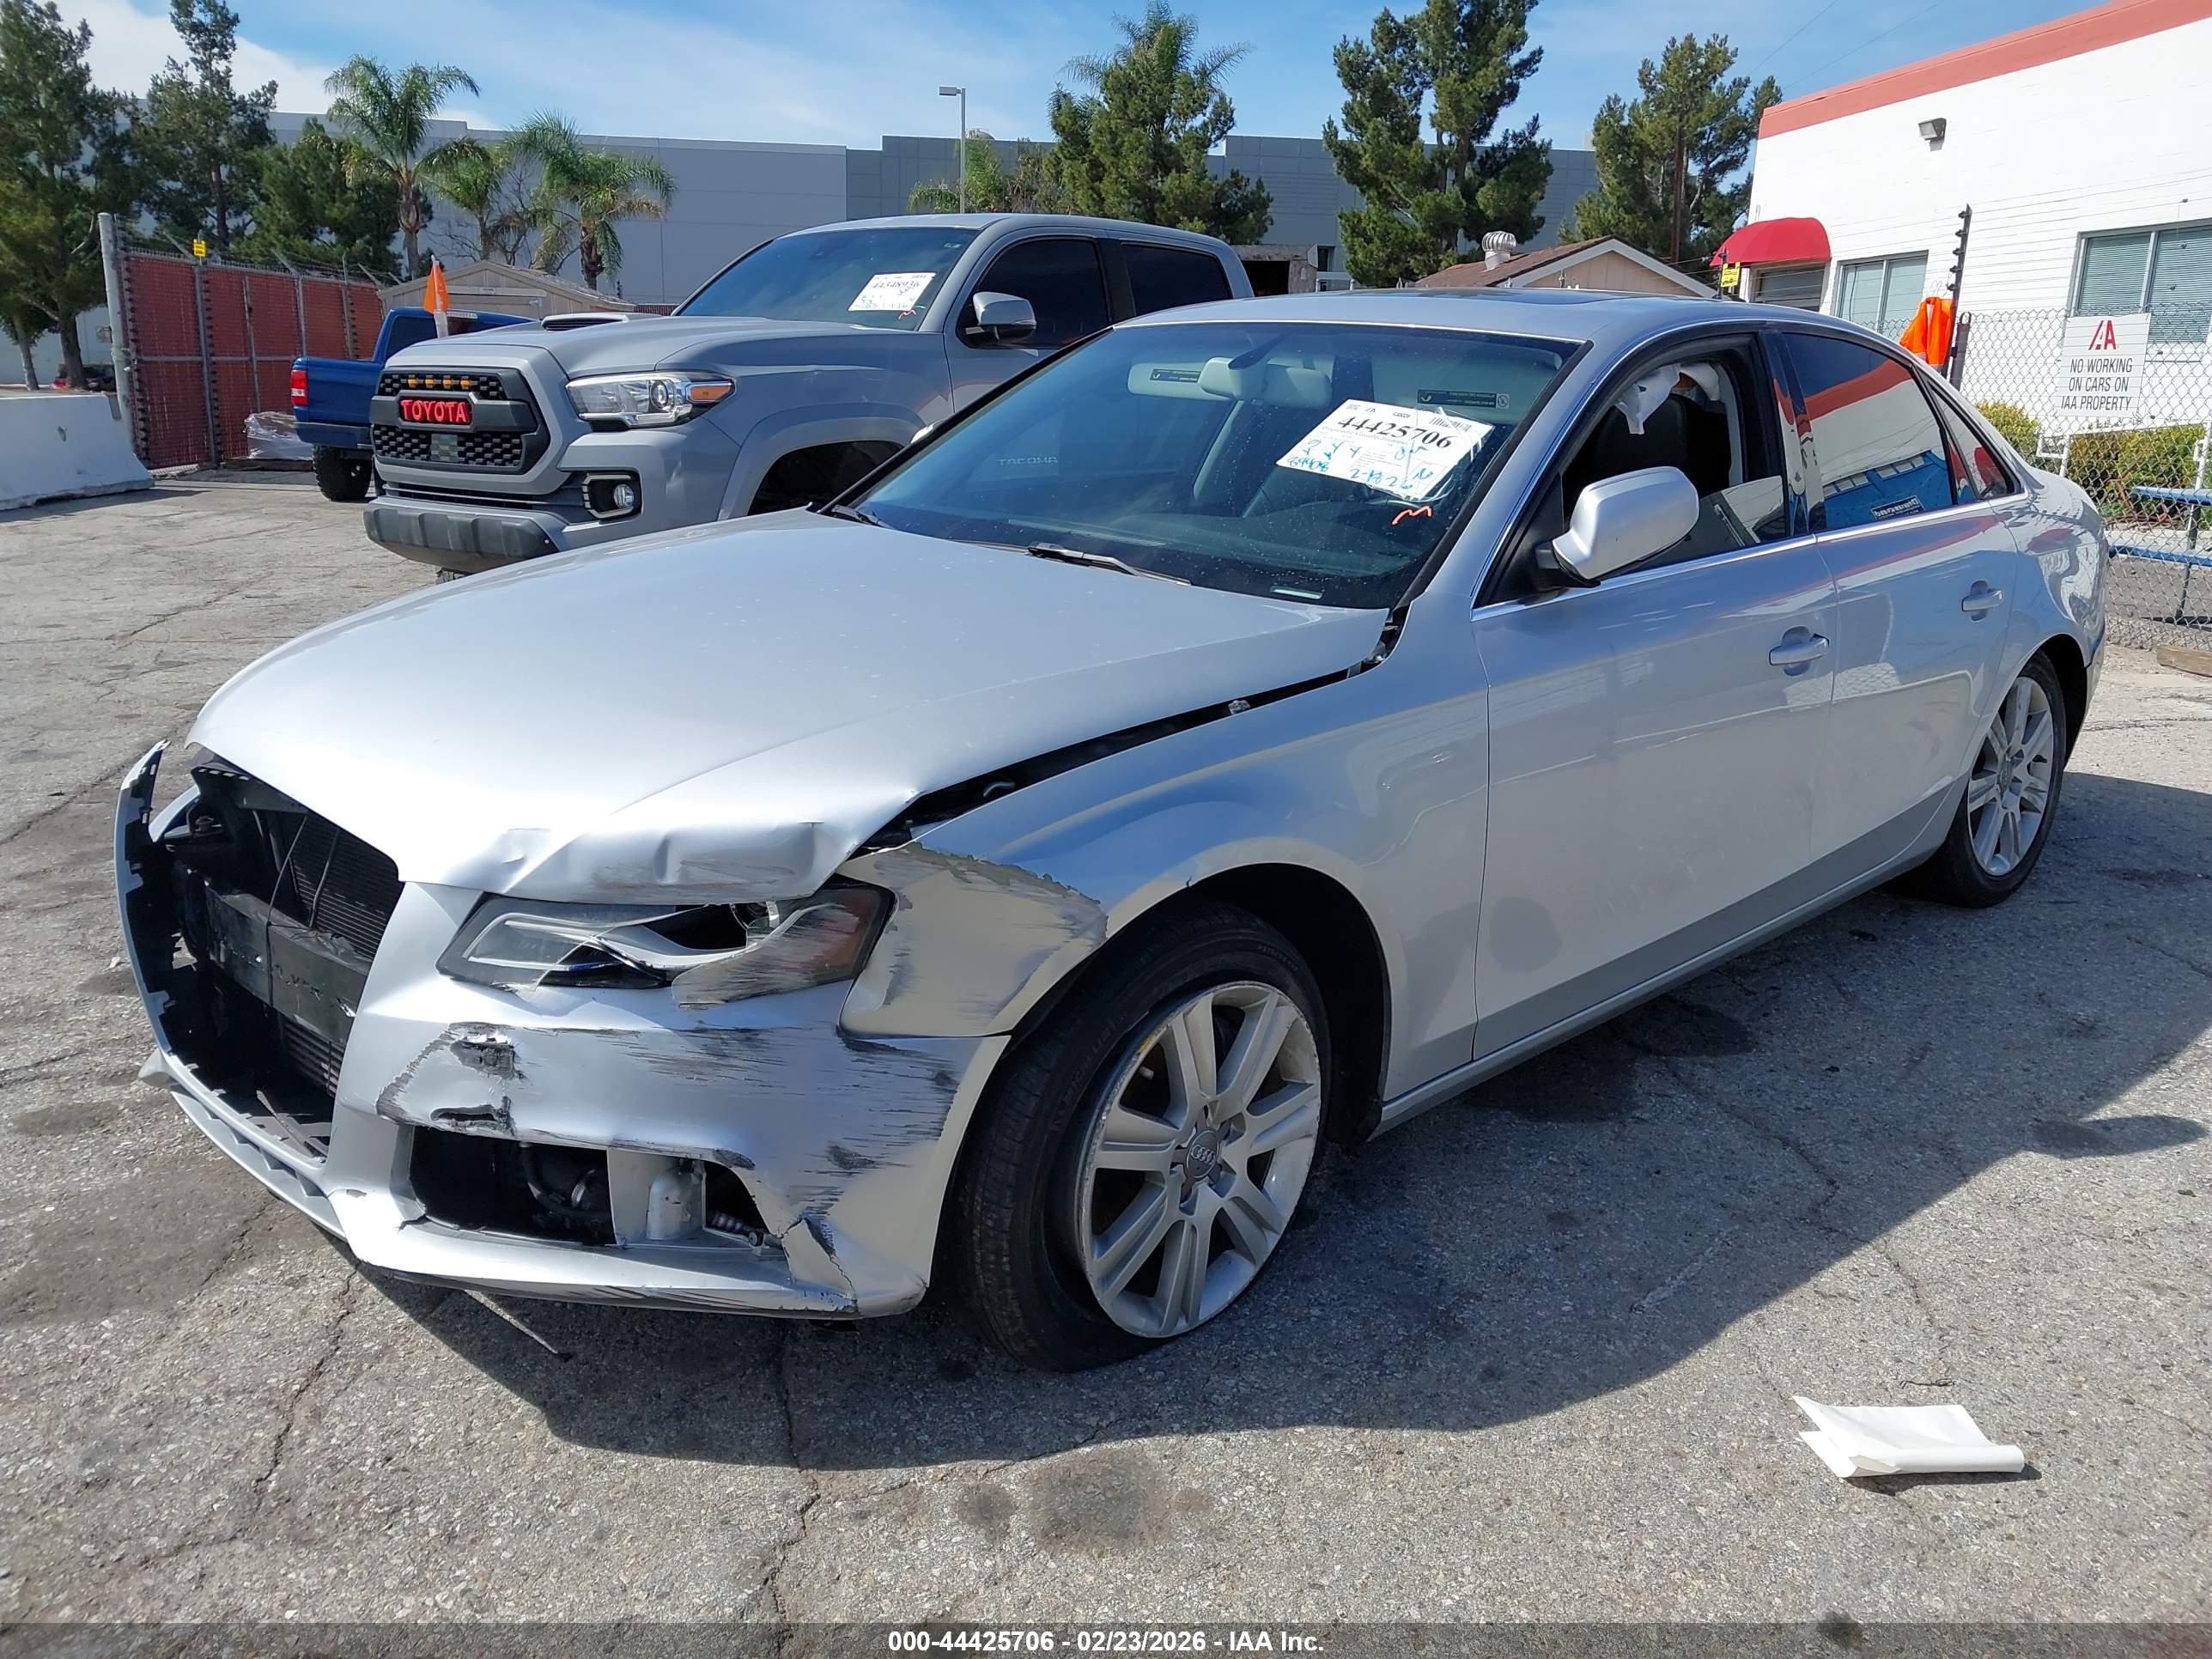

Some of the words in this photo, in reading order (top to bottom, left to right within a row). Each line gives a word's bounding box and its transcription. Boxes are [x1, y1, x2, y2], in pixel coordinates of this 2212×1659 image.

[2070, 358, 2084, 374] NO
[2087, 357, 2133, 374] WORKING
[2069, 377, 2081, 392] ON
[2085, 377, 2111, 392] CARS
[2114, 377, 2129, 392] ON
[400, 399, 467, 422] TOYOTA
[2061, 396, 2076, 410] IAA
[2080, 396, 2131, 411] PROPERTY
[1337, 416, 1458, 448] 44425706
[995, 457, 1059, 466] TACOMA
